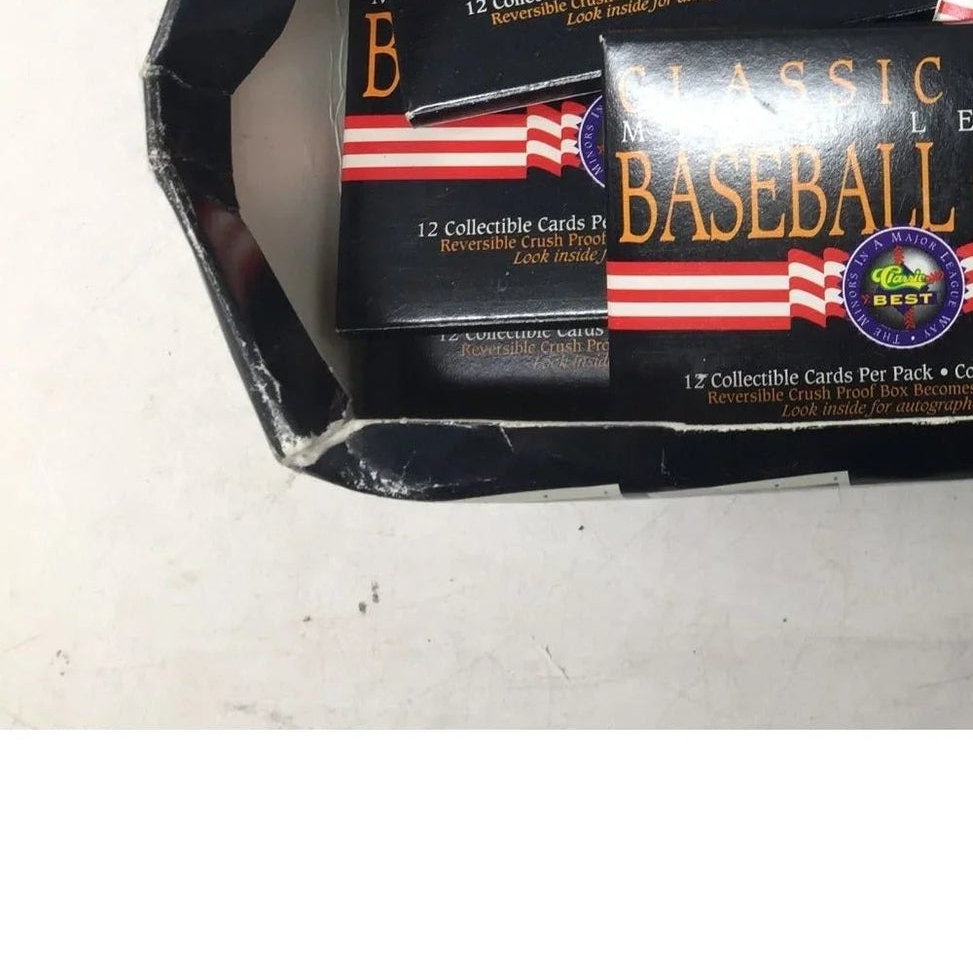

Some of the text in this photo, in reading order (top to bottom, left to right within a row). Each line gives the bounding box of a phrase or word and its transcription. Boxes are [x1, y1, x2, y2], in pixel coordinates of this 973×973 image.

[491, 0, 567, 25] Reversible
[566, 6, 601, 27] Look
[615, 140, 955, 244] BASEBALL
[417, 221, 438, 238] 12
[444, 217, 532, 236] Collectible
[537, 214, 585, 232] Cards
[440, 236, 517, 252] Reversible
[521, 233, 563, 249] Crush
[513, 248, 549, 265] Look
[553, 247, 597, 263] inside
[872, 292, 933, 306] BEST
[711, 369, 799, 388] Collectible
[804, 366, 853, 385] Cards
[859, 367, 887, 382] Per
[893, 364, 934, 381] Pack
[707, 388, 784, 404] Reversible
[788, 386, 831, 402] Crush
[836, 384, 875, 400] Proof
[880, 384, 908, 398] Box
[781, 402, 818, 418] Look
[822, 400, 866, 416] inside
[864, 399, 892, 418] for
